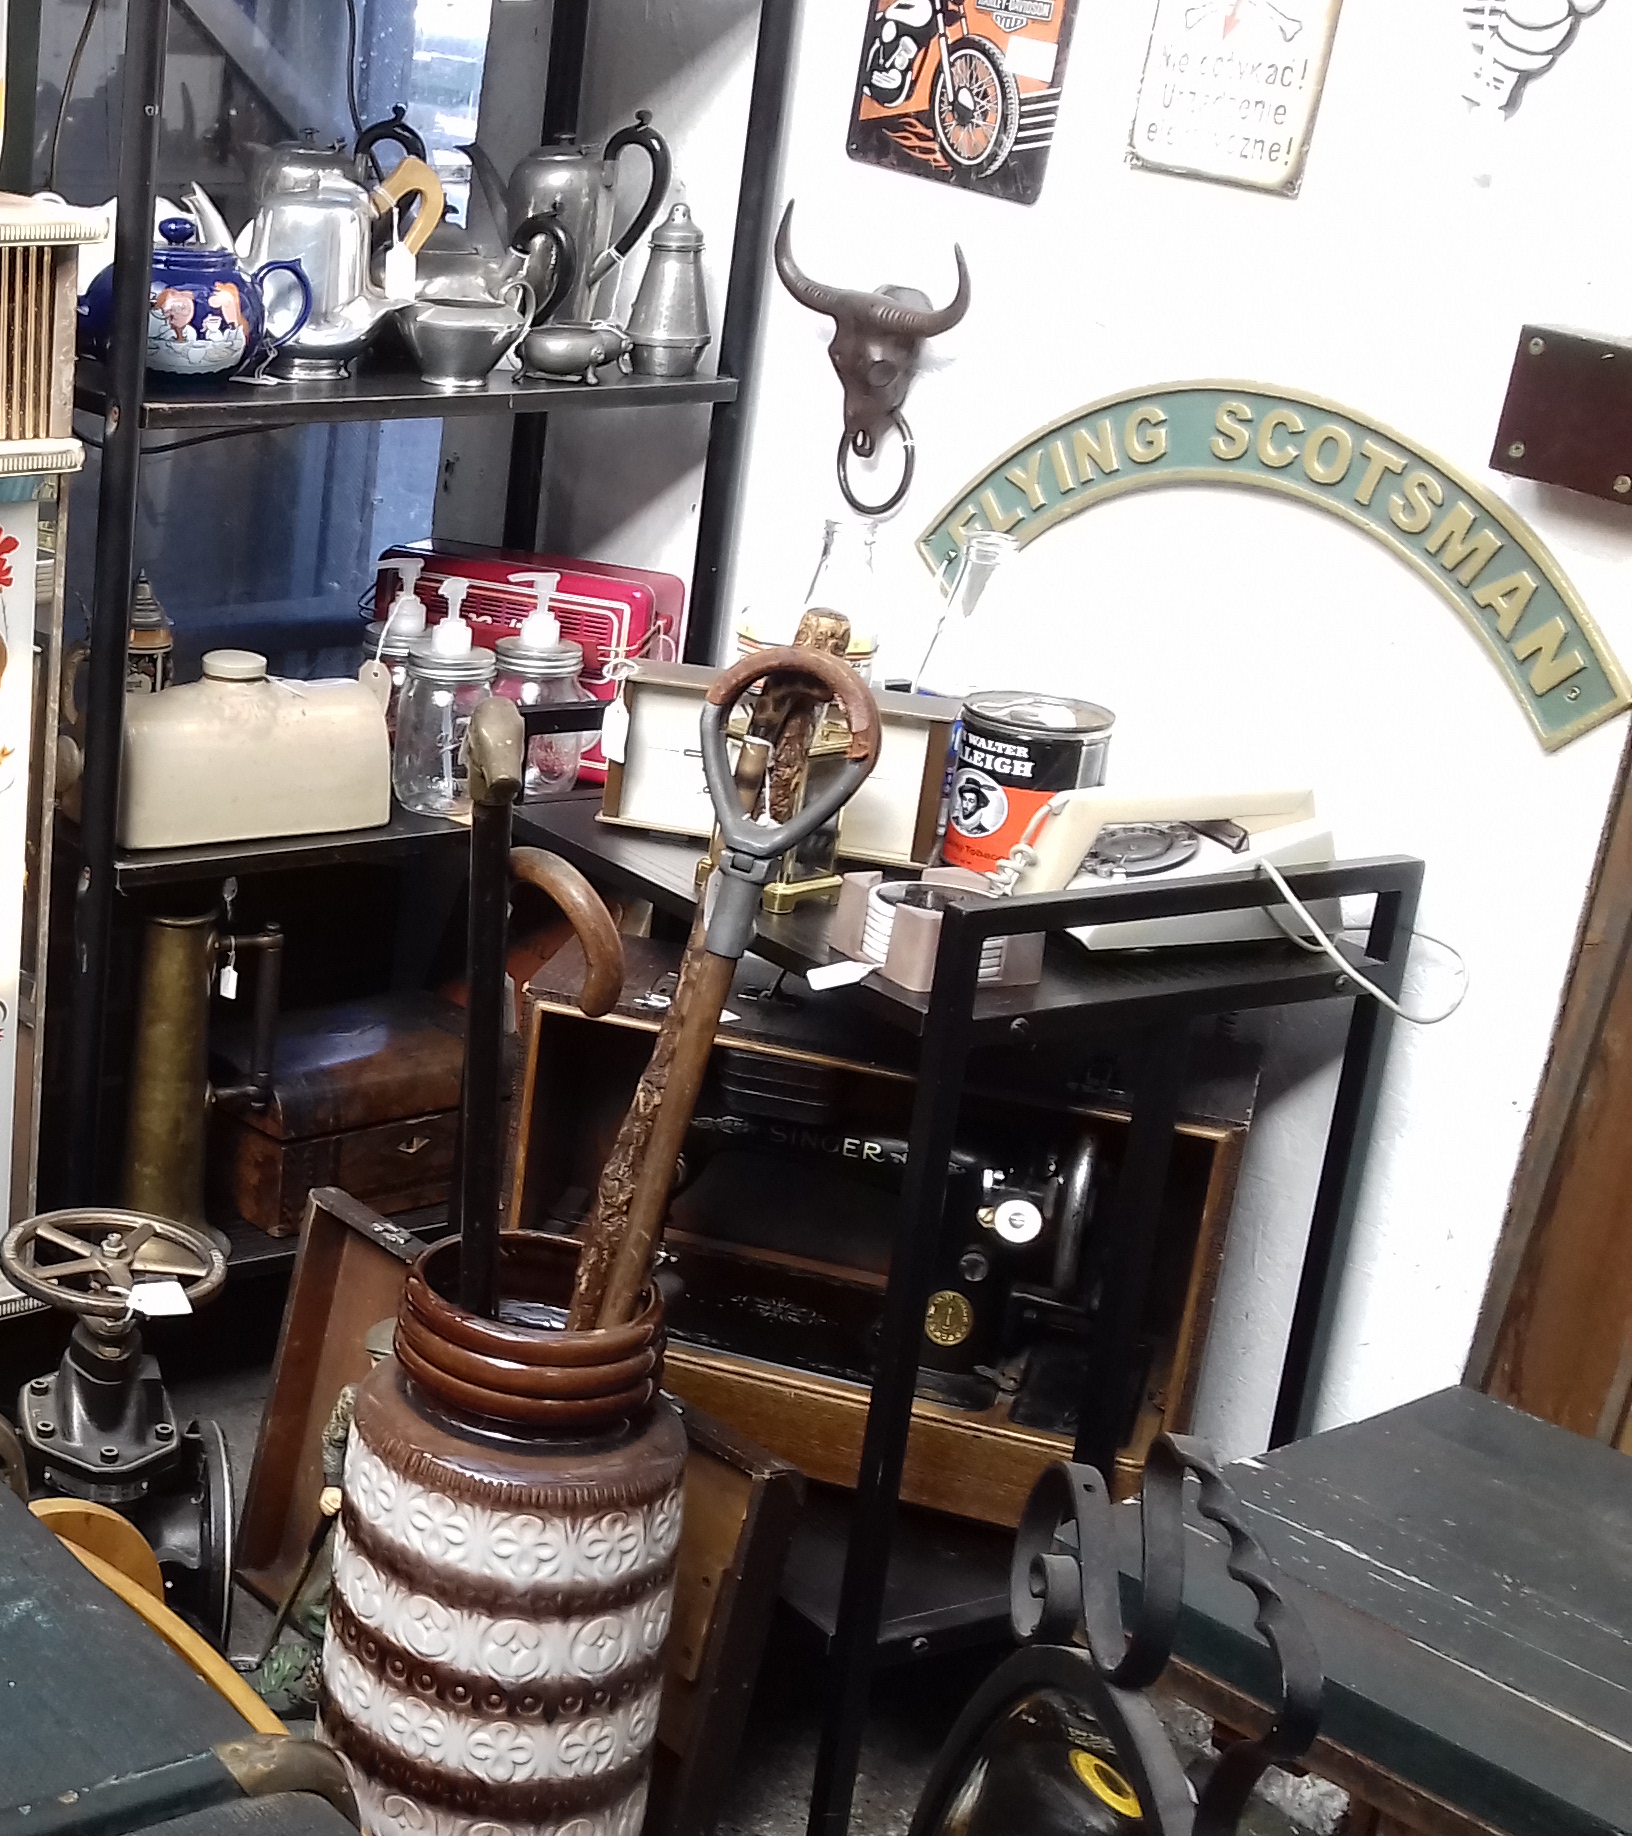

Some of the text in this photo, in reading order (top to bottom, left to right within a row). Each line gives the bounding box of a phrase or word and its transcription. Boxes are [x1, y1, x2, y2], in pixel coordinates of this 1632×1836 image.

[948, 401, 1588, 698] FLYING SCOTSMAN
[960, 746, 1035, 778] LEIGH
[969, 733, 1029, 758] WALTER
[770, 1125, 886, 1165] SINGER
